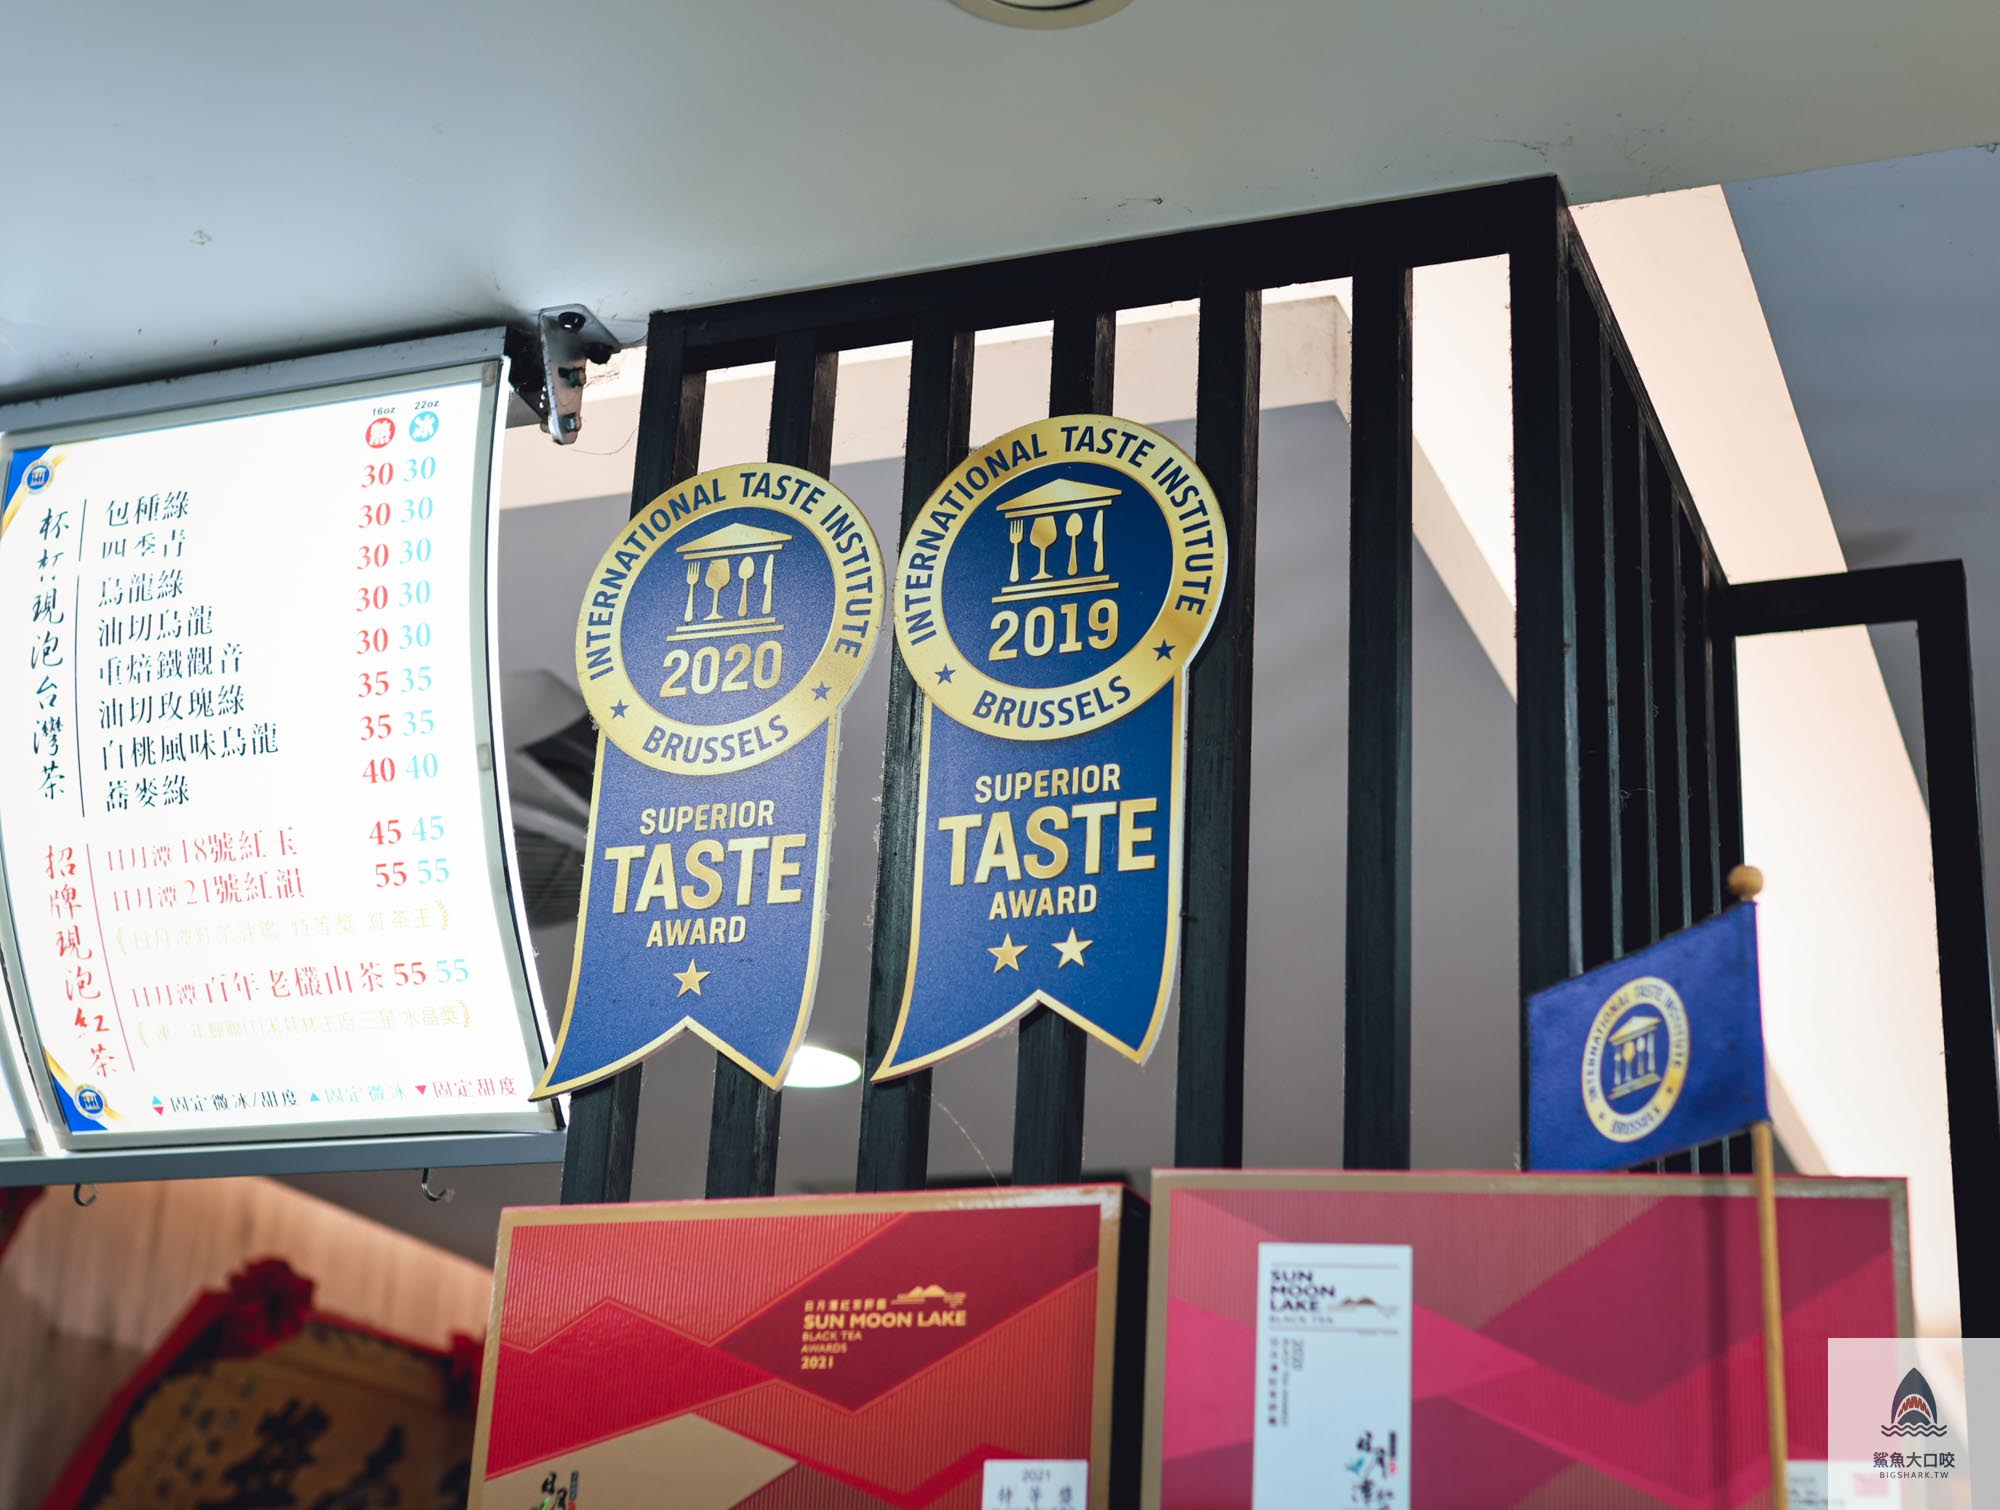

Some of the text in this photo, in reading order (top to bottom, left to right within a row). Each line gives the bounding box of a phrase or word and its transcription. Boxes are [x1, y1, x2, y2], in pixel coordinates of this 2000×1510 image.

[372, 400, 440, 416] 16oz 22oz
[107, 457, 437, 528] 包種綠 30 30
[359, 503, 391, 528] 30
[401, 497, 433, 522] 30
[904, 425, 1214, 646] INTERNATIONAL TASTE INSTITUTE
[98, 539, 432, 608] 烏龍綠 30 30
[586, 472, 873, 681] INTERNATIONAL TASTE INSTITUTE
[98, 580, 431, 647] 油切烏龍 30 30
[988, 598, 1120, 662] 2019
[356, 628, 389, 655] 30
[399, 623, 432, 650] 30
[659, 640, 783, 698] 2020
[98, 666, 433, 730] 油切玫瑰綠 35 35
[972, 675, 1131, 729] BRUSSELS
[100, 709, 435, 771] 白桃風味烏龍 35 35
[642, 715, 789, 764] BRUSSELS
[363, 758, 396, 784] 40
[407, 753, 439, 780] 40
[974, 763, 1121, 804] SUPERIOR
[370, 820, 402, 846] 45
[412, 815, 445, 841] 45
[639, 799, 776, 835] SUPERIOR
[937, 797, 1158, 886] TASTE
[376, 862, 408, 888] 55
[418, 857, 450, 884] 55
[604, 833, 808, 914] TASTE
[988, 884, 1099, 921] AWARD
[645, 915, 748, 948] AWARD
[44, 844, 118, 1078] 招牌現泡紅茶
[394, 962, 427, 988] 55
[436, 958, 470, 984] 55
[432, 1076, 518, 1098] 固定甜度
[1270, 1269, 1313, 1282] SUN
[1270, 1285, 1336, 1298] MOON
[803, 1309, 967, 1330] SUN MOON LAKE
[1269, 1299, 1319, 1312] LAKE
[801, 1343, 848, 1354] AWARDS
[802, 1329, 863, 1342] BLACK TEA
[800, 1355, 834, 1370] 2021
